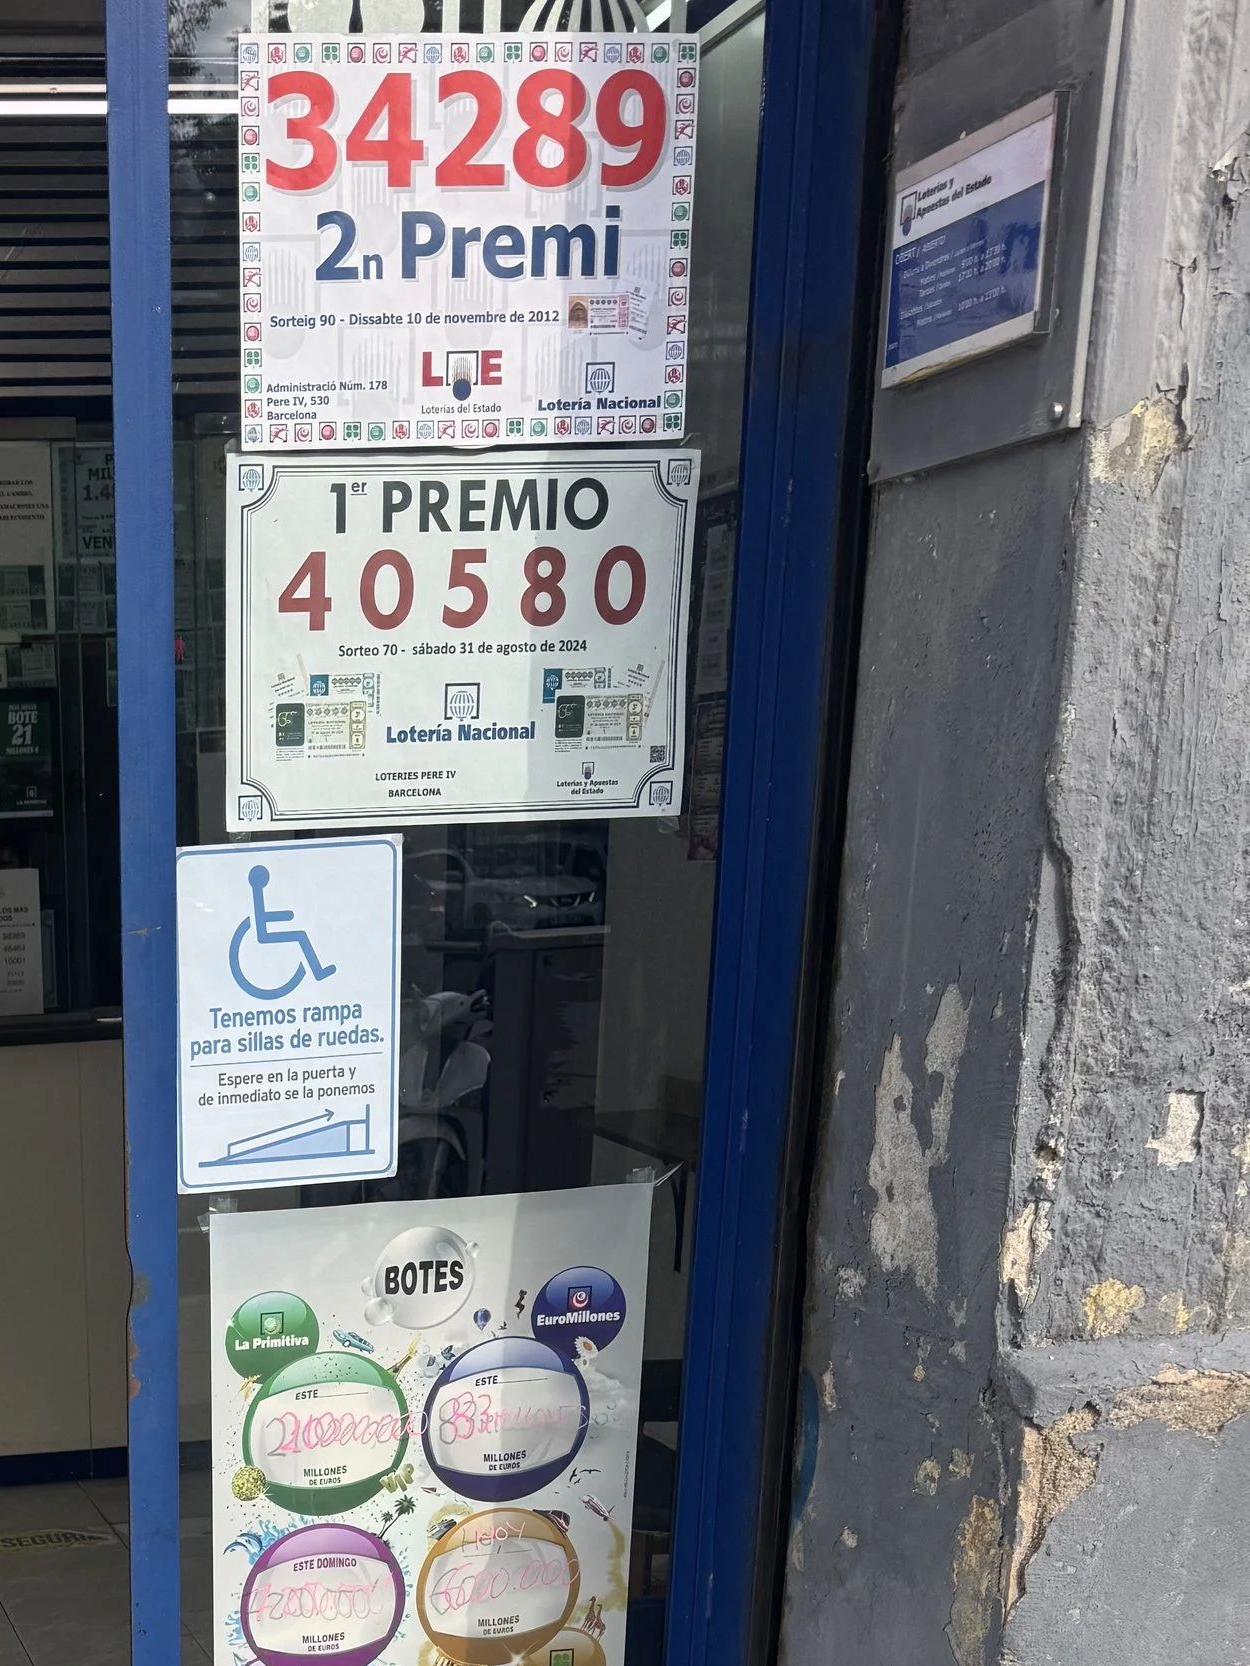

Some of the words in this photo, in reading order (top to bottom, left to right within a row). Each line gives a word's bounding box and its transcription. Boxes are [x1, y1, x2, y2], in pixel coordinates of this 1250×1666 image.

[265, 68, 668, 192] 34289
[916, 197, 950, 218] Apuestas
[952, 188, 964, 202] del
[965, 175, 992, 195] Estado
[315, 210, 384, 282] 2n
[401, 205, 621, 280] Premi
[269, 315, 315, 329] Sorteig
[320, 314, 335, 326] 90
[350, 313, 403, 325] Dissabte
[407, 313, 422, 324] 10
[425, 312, 440, 324] de
[444, 312, 506, 324] novembre
[510, 311, 524, 323] de
[528, 311, 559, 322] 2012
[267, 381, 336, 392] Administració
[339, 380, 366, 391] Núm.
[369, 380, 387, 390] 178
[267, 396, 290, 407] Pere
[293, 396, 308, 407] IV,
[311, 395, 329, 406] 530
[421, 403, 454, 414] Loterías
[457, 403, 470, 413] del
[473, 402, 501, 413] Estado
[538, 398, 591, 411] Lotería
[597, 395, 661, 409] Nacional
[267, 410, 317, 420] Barcelona
[381, 477, 609, 533] PREMIO
[338, 644, 380, 656] Sorteo
[383, 644, 397, 656] 70
[412, 642, 456, 655] sábado
[459, 642, 473, 654] 31
[477, 641, 493, 654] de
[496, 642, 537, 656] agosto
[540, 640, 555, 653] de
[559, 640, 587, 652] 2024
[8, 711, 38, 724] BOTE
[11, 724, 32, 745] 21
[386, 723, 452, 744] Lotería
[457, 721, 535, 741] Nacional
[375, 772, 419, 781] LOTERIES
[421, 771, 444, 780] PERE
[446, 770, 456, 779] IV
[388, 787, 441, 798] BARCELONA
[209, 1007, 296, 1029] Tenemos
[303, 1003, 362, 1028] rampa
[190, 1036, 232, 1061] para
[237, 1030, 284, 1053] sillas
[290, 1028, 312, 1049] de
[318, 1025, 385, 1047] ruedas.
[218, 1072, 263, 1090] Espere
[267, 1072, 283, 1083] en
[287, 1068, 299, 1082] la
[303, 1066, 346, 1085] puerta
[349, 1065, 357, 1081] y
[199, 1092, 214, 1107] de
[218, 1089, 281, 1105] inmediato
[284, 1090, 299, 1101] se
[303, 1086, 314, 1100] la
[317, 1083, 375, 1102] ponemos
[384, 1260, 464, 1296] BOTES
[536, 1309, 620, 1328] EuroMillones
[234, 1338, 250, 1352] La
[252, 1334, 309, 1350] Primitiva
[475, 1375, 499, 1386] ESTE
[295, 1389, 319, 1400] ESTE
[483, 1450, 527, 1462] MILLONES
[303, 1465, 347, 1477] MILLONES
[499, 1462, 520, 1470] EUROS
[320, 1477, 341, 1485] EUROS
[293, 1559, 314, 1572] ESTE
[317, 1557, 357, 1569] DOMINGO
[478, 1615, 520, 1627] MILLONES
[302, 1632, 345, 1644] MILLONES
